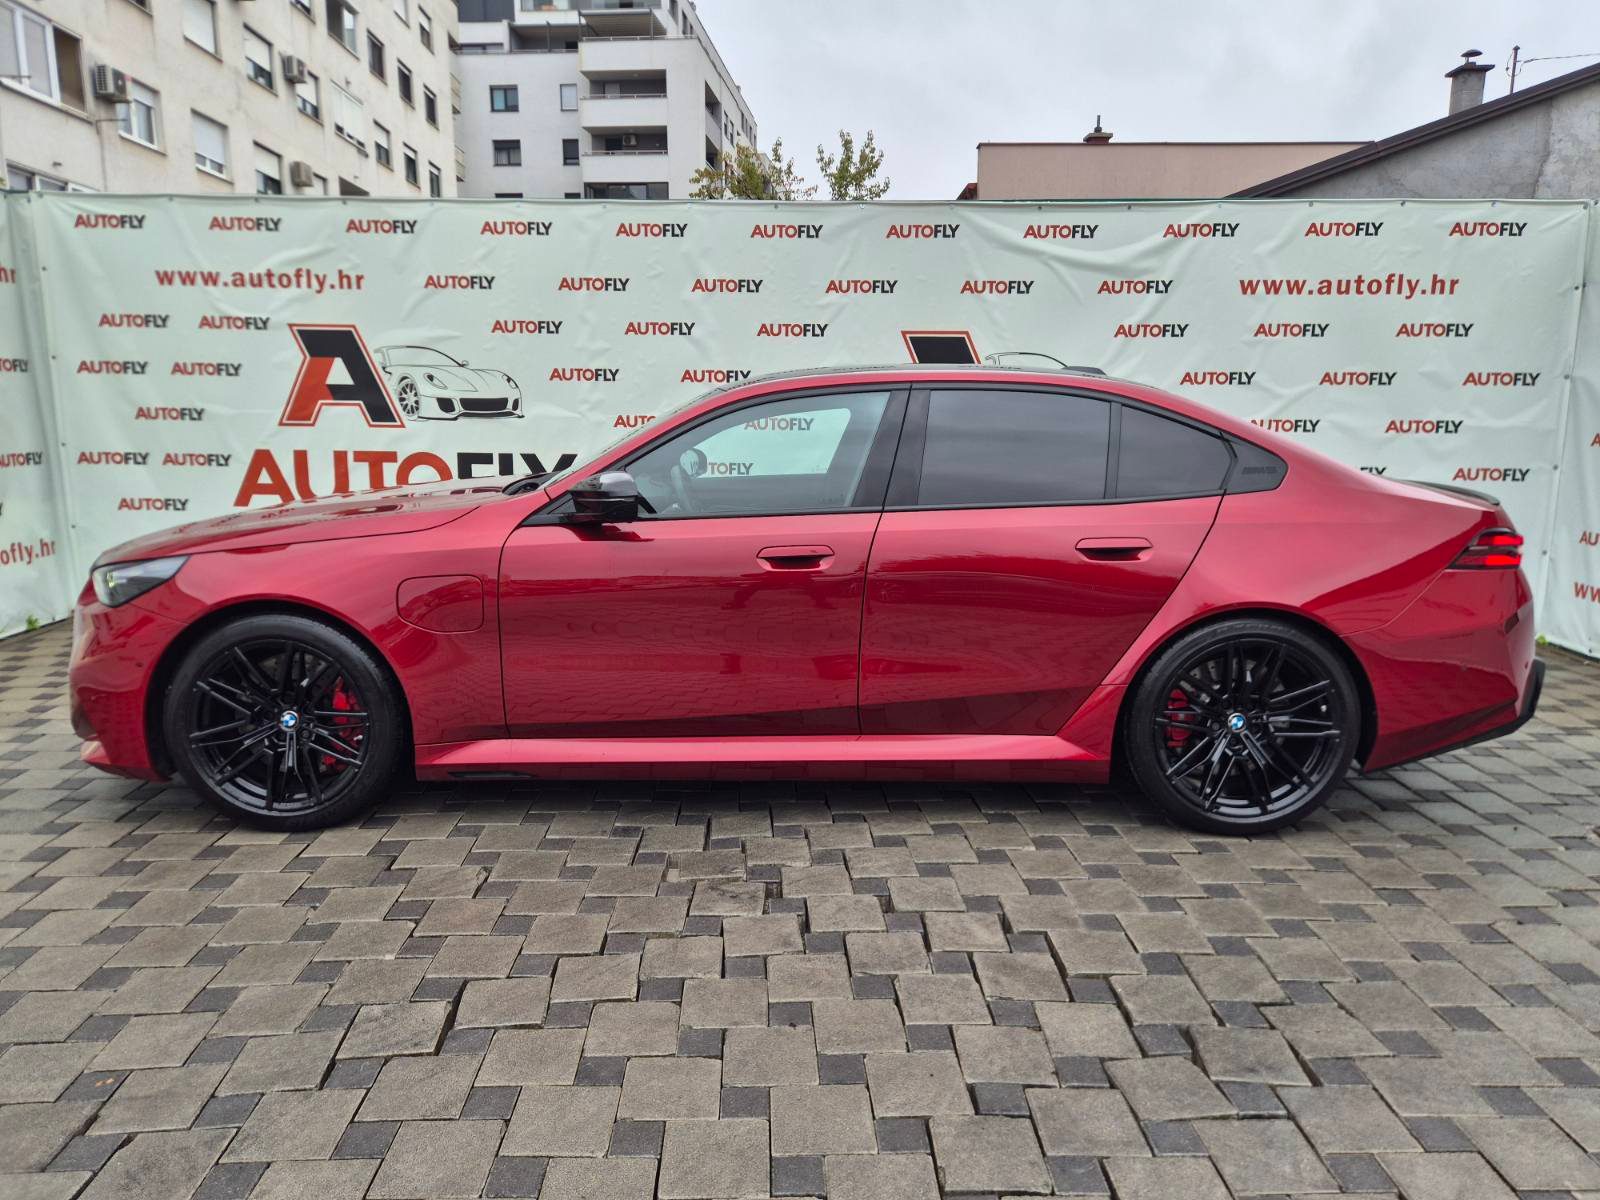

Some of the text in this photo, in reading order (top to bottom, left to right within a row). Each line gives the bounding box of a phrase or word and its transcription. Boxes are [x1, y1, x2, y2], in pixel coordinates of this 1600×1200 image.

[75, 215, 145, 229] AUTOFLY
[210, 217, 281, 231] AUTOFLY
[346, 220, 417, 233] AUTOFLY
[481, 221, 552, 235] AUTOFLY
[616, 223, 688, 237] AUTOFLY
[751, 225, 823, 238] AUTOFLY
[886, 224, 960, 238] AUTOFLY
[1024, 225, 1099, 238] AUTOFLY
[1163, 223, 1240, 238] AUTOFLY
[1305, 222, 1383, 236] AUTOFLY
[1449, 222, 1528, 236] AUTOFLY
[155, 268, 364, 294] www.autofly.hr
[424, 276, 495, 289] AUTOFLY
[558, 278, 630, 291] AUTOFLY
[692, 279, 763, 293] AUTOFLY
[825, 280, 898, 293] AUTOFLY
[960, 281, 1034, 294] AUTOFLY
[1098, 280, 1173, 294] AUTOFLY
[1240, 273, 1459, 299] www.autofly.hr
[99, 314, 169, 328] AUTOFLY
[199, 316, 269, 330] AUTOFLY
[492, 320, 563, 334] AUTOFLY
[625, 322, 695, 335] AUTOFLY
[757, 324, 829, 337] AUTOFLY
[1114, 324, 1189, 337] AUTOFLY
[1254, 324, 1330, 337] AUTOFLY
[1396, 323, 1474, 337] AUTOFLY
[77, 361, 148, 374] AUTOFLY
[171, 363, 242, 376] AUTOFLY
[549, 368, 619, 381] AUTOFLY
[1180, 372, 1256, 385] AUTOFLY
[1320, 372, 1397, 385] AUTOFLY
[1463, 373, 1541, 386] AUTOFLY
[136, 407, 204, 421] AUTOFLY
[744, 417, 815, 431] AUTOFLY
[1385, 420, 1463, 434] AUTOFLY
[78, 452, 149, 465] AUTOFLY
[163, 453, 231, 466] AUTOFLY
[709, 462, 753, 475] TOFLY
[1453, 468, 1530, 481] AUTOFLY
[118, 498, 188, 511] AUTOFLY
